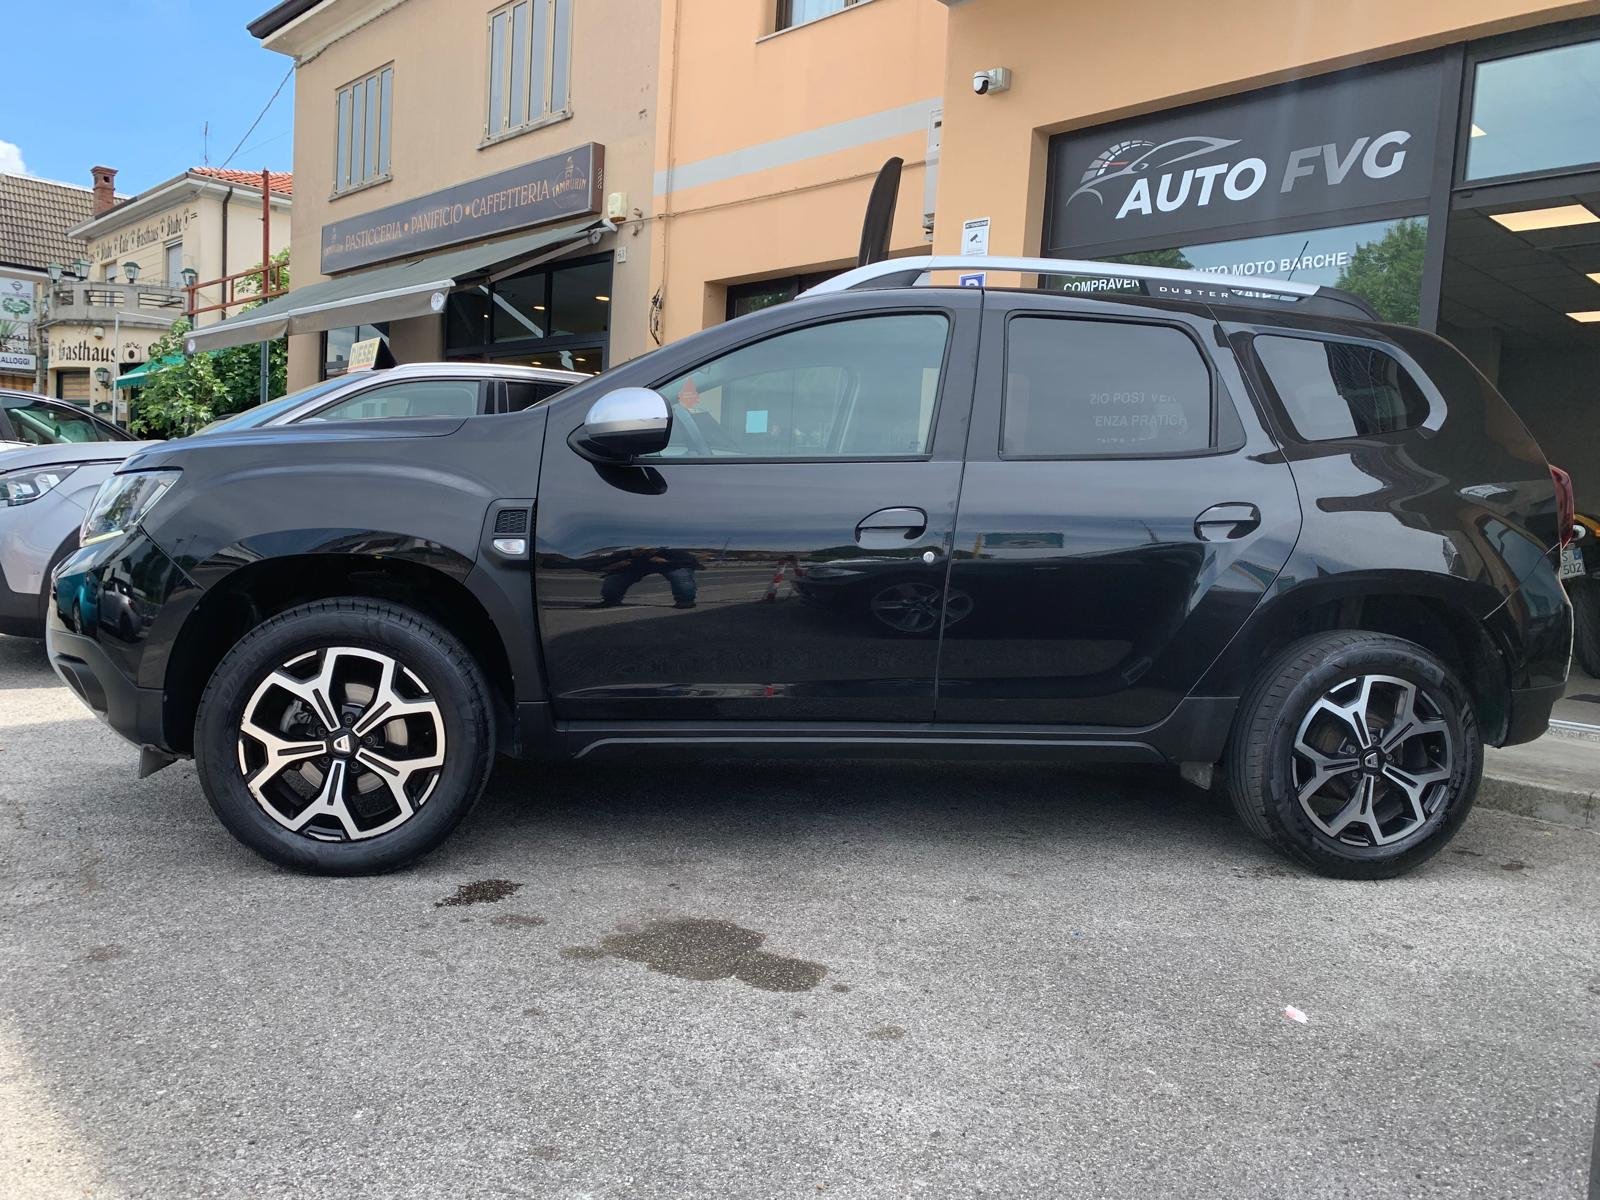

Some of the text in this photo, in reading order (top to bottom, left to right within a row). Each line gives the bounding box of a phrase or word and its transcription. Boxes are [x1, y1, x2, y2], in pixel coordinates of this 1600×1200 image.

[1115, 130, 1412, 219] AUTO FVG
[345, 179, 550, 252] PASTICCERIA PANIFICIO CAFFETTERIA
[1063, 278, 1141, 293] COMPRAVEN
[1232, 260, 1276, 276] MOTO
[1280, 252, 1348, 272] BARCHE
[1159, 286, 1229, 299] DUSTER
[1, 356, 30, 365] ALLOGGI
[58, 338, 116, 363] Gasthaus
[1563, 562, 1583, 575] 502
